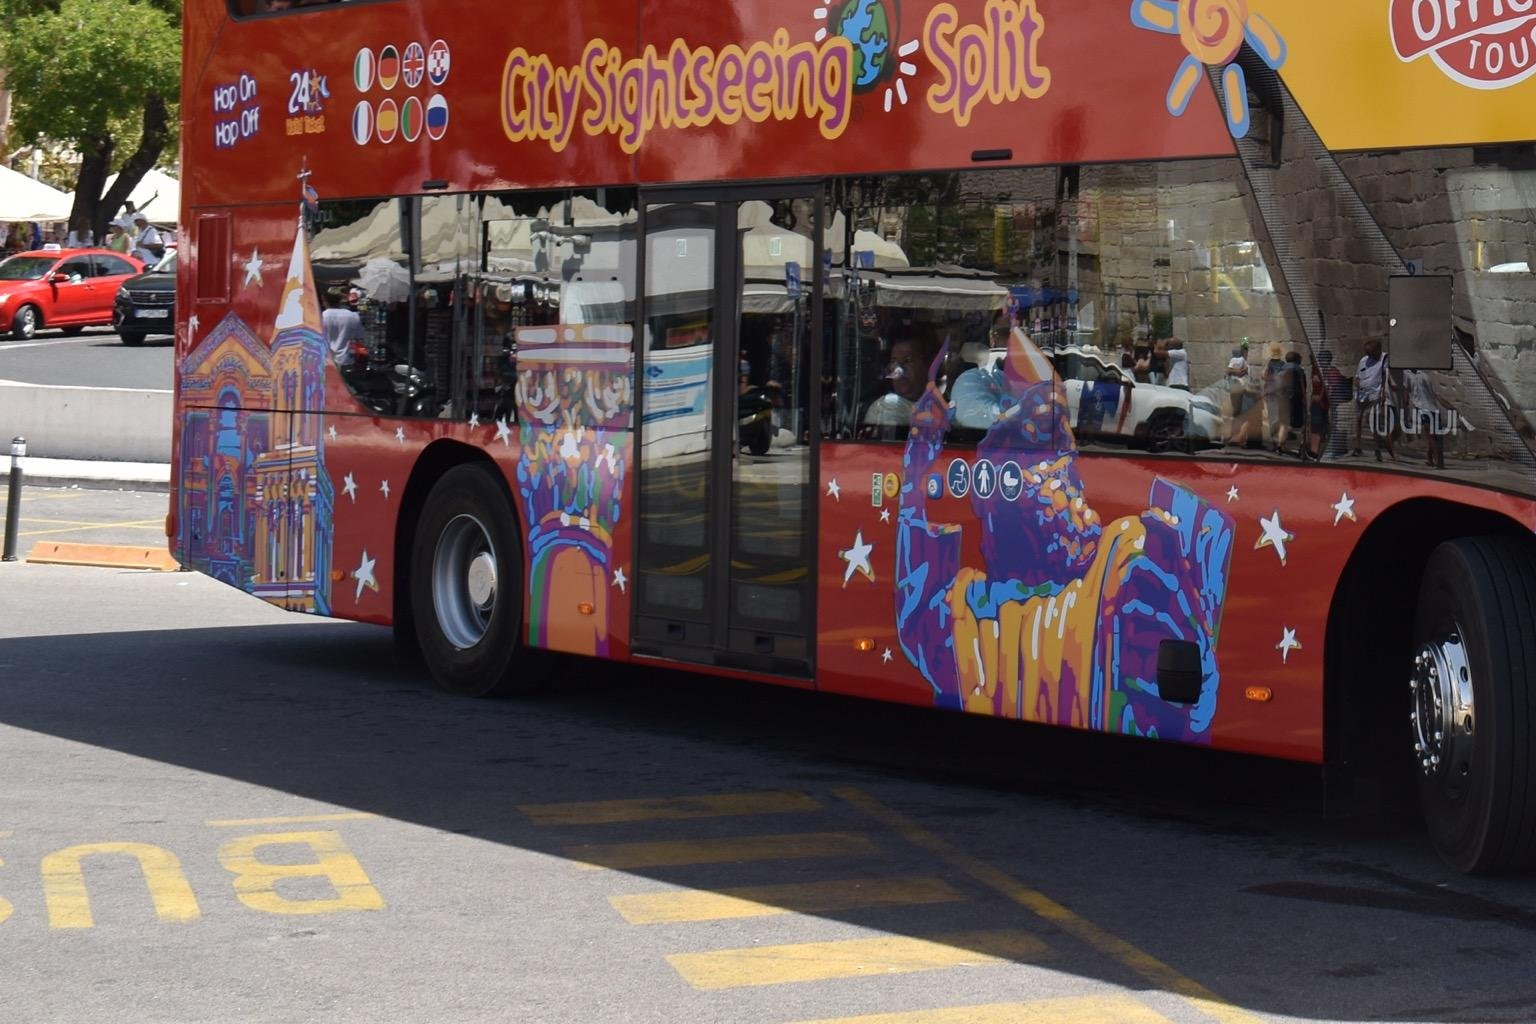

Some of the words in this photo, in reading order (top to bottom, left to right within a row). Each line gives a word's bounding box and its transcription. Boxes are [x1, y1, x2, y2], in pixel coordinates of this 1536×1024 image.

[214, 86, 237, 111] Hop
[240, 75, 256, 101] On
[501, 26, 854, 153] CitySightseeing
[216, 121, 239, 146] Hop
[241, 107, 259, 136] Off
[0, 829, 386, 930] BU
